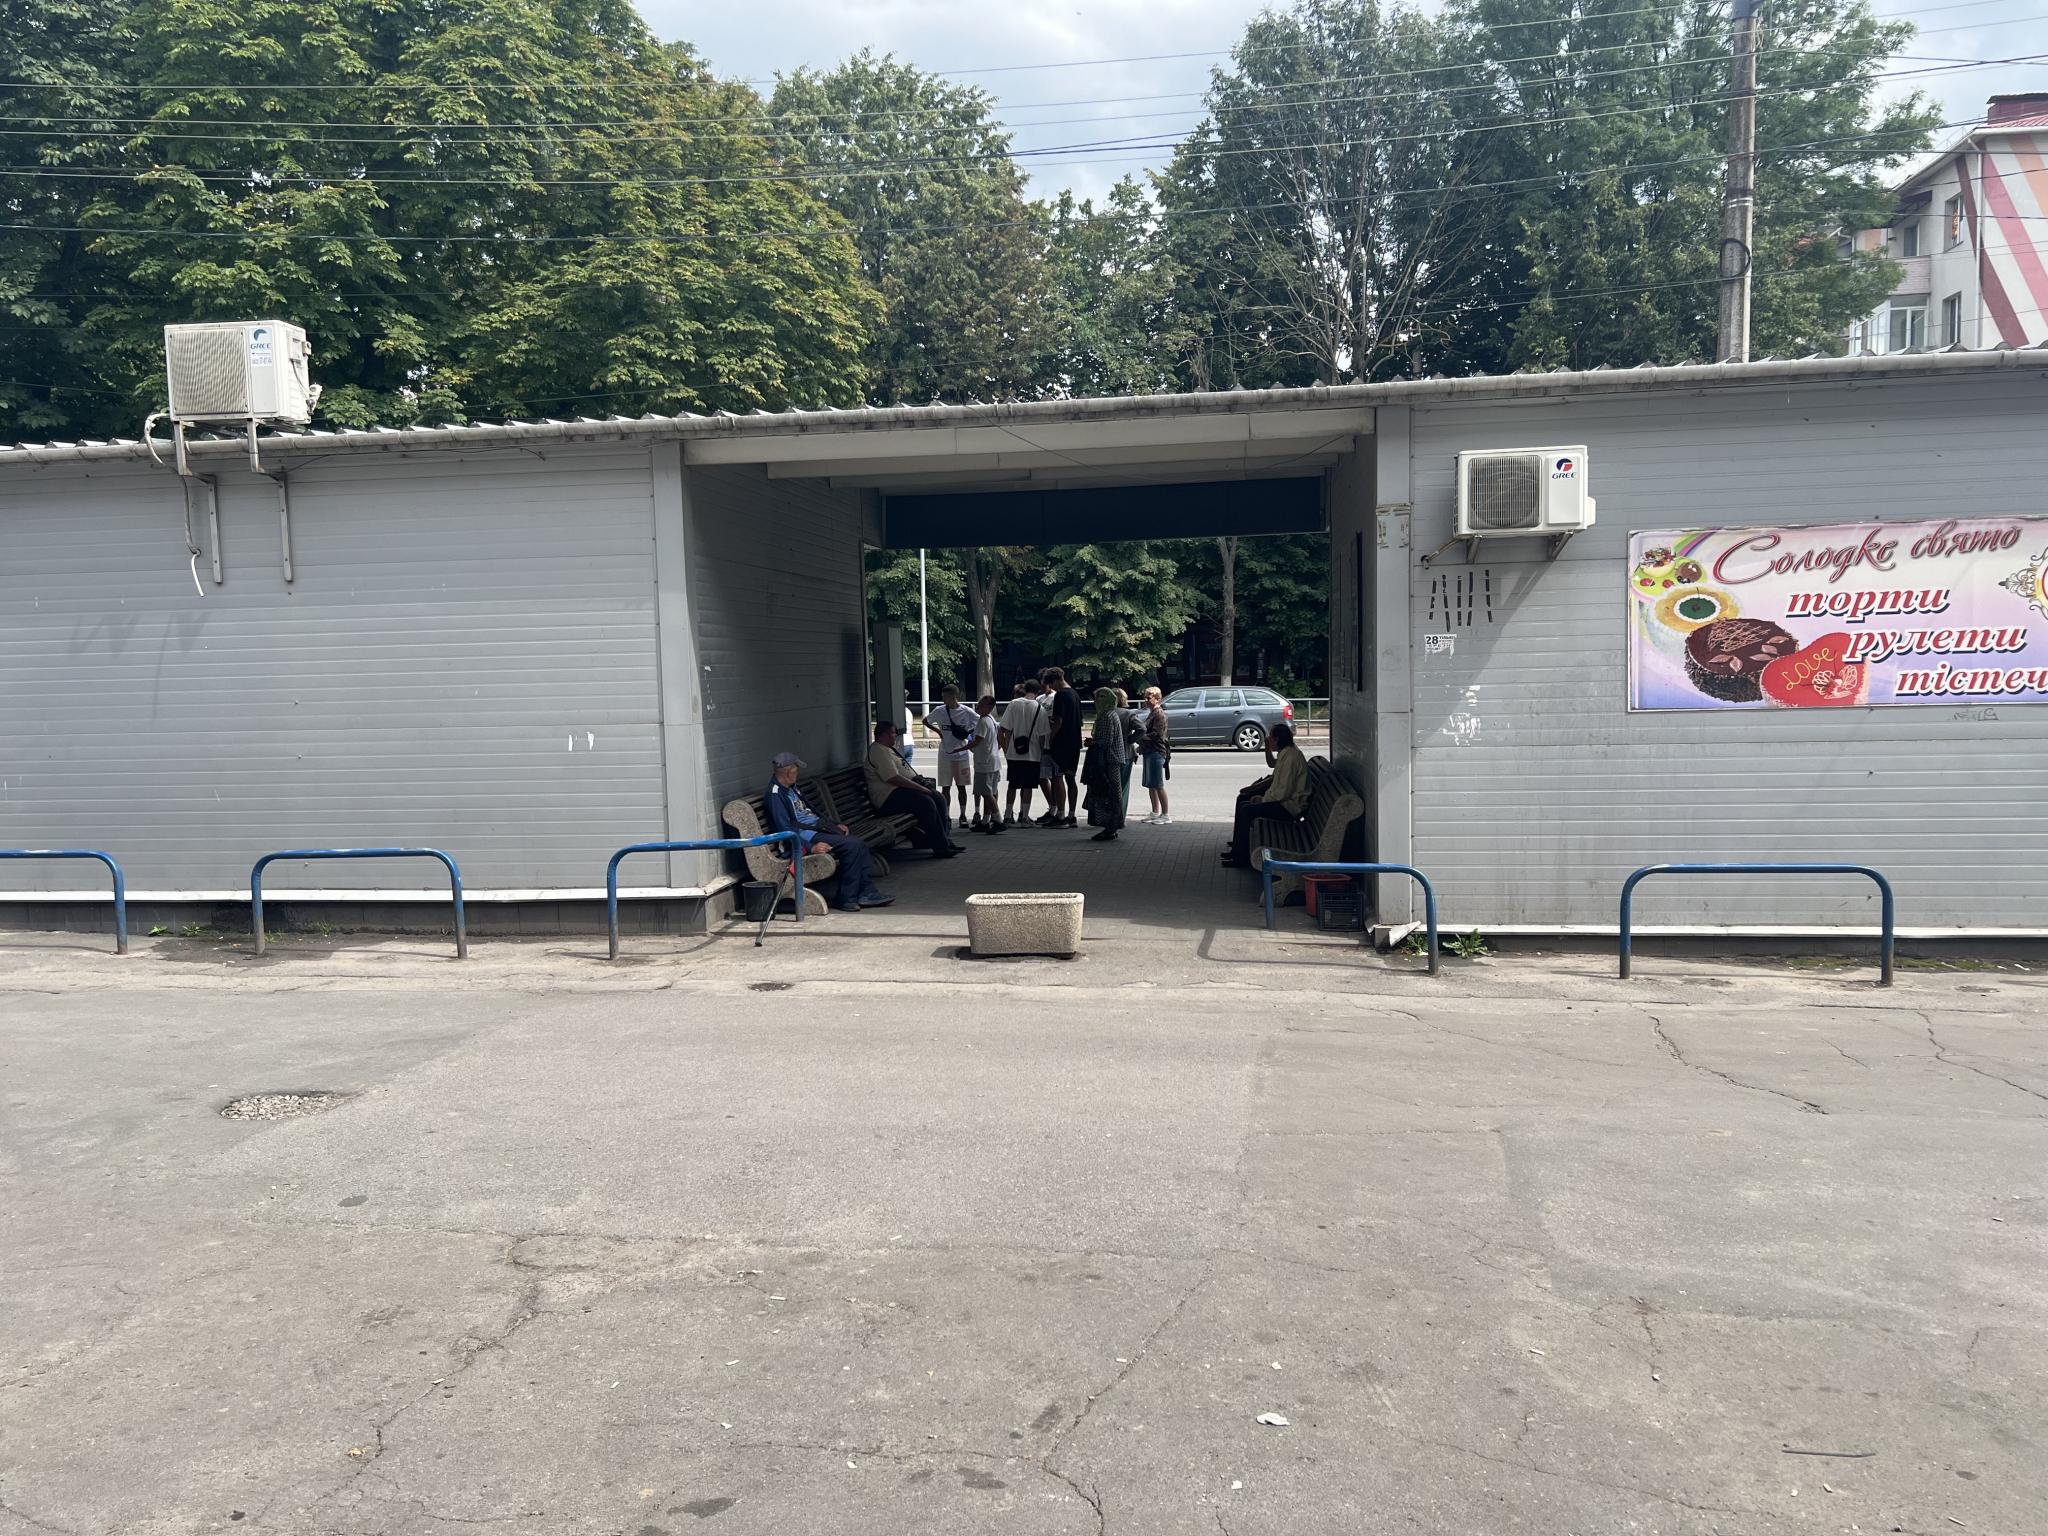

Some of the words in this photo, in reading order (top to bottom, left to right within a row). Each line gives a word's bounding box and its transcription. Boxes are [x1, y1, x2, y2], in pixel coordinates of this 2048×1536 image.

[1552, 471, 1577, 480] GREE
[1714, 527, 1898, 584] Солодке
[1910, 520, 2022, 558] свято
[1787, 586, 1948, 620] торти
[1425, 635, 1439, 645] 28
[1844, 624, 2023, 661] рулети
